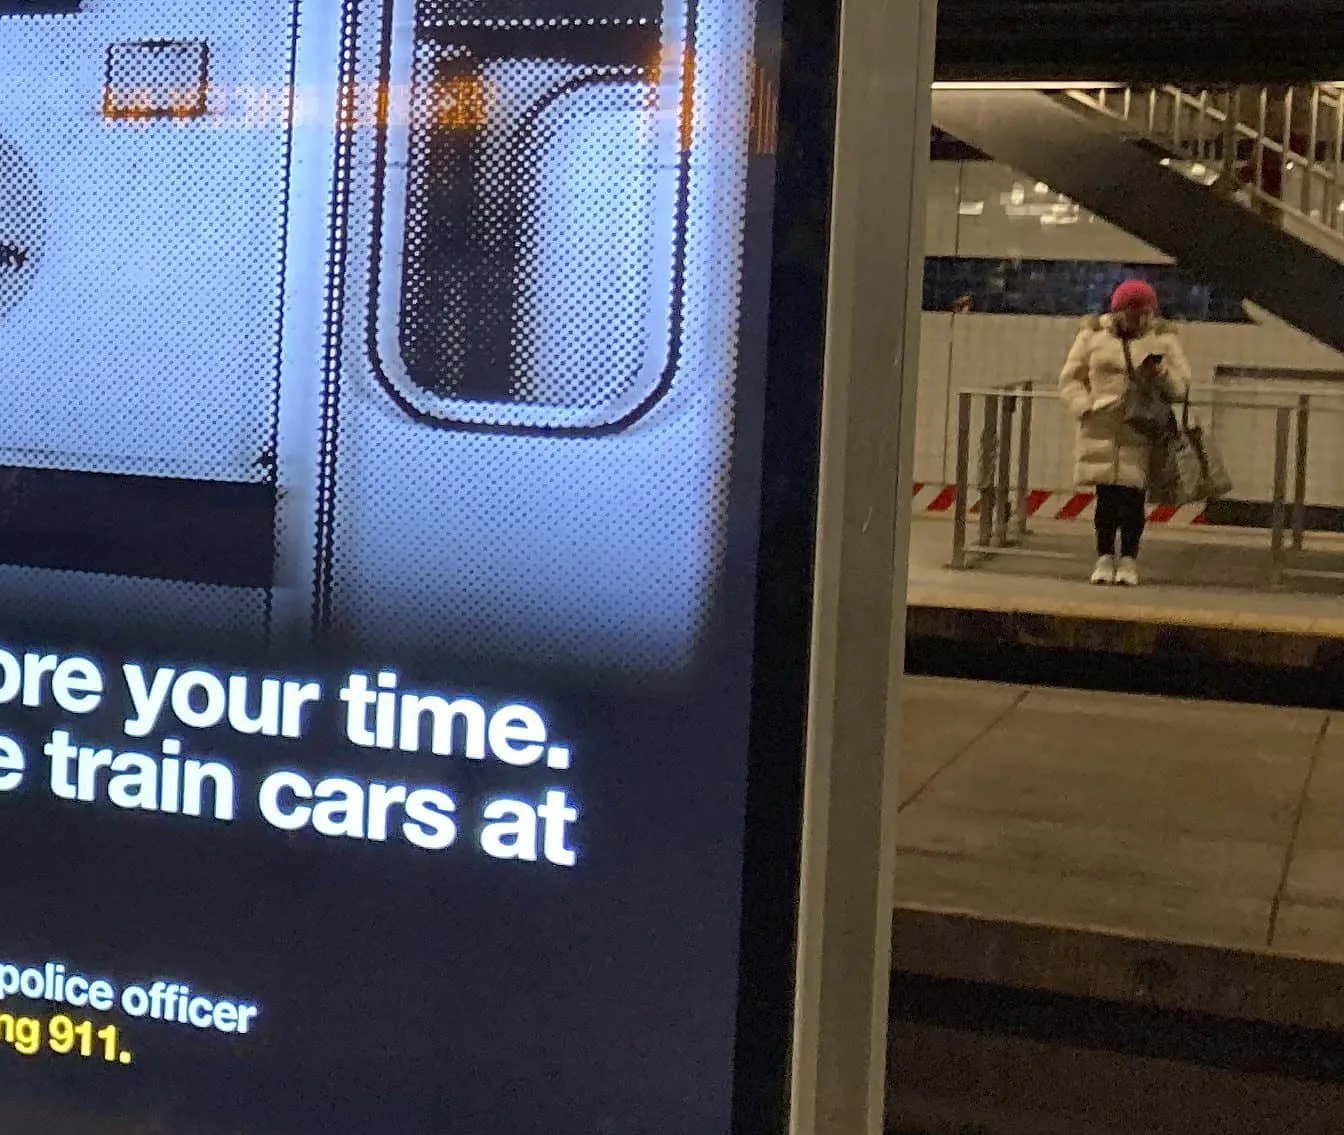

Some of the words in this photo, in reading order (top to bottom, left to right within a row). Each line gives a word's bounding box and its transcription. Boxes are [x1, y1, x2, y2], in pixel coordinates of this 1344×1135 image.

[123, 663, 320, 738] your
[340, 671, 570, 770] time.
[45, 730, 234, 820] train
[259, 769, 456, 850] cars
[480, 790, 578, 866] at
[49, 1014, 133, 1065] 911.
[122, 981, 258, 1034] officer
